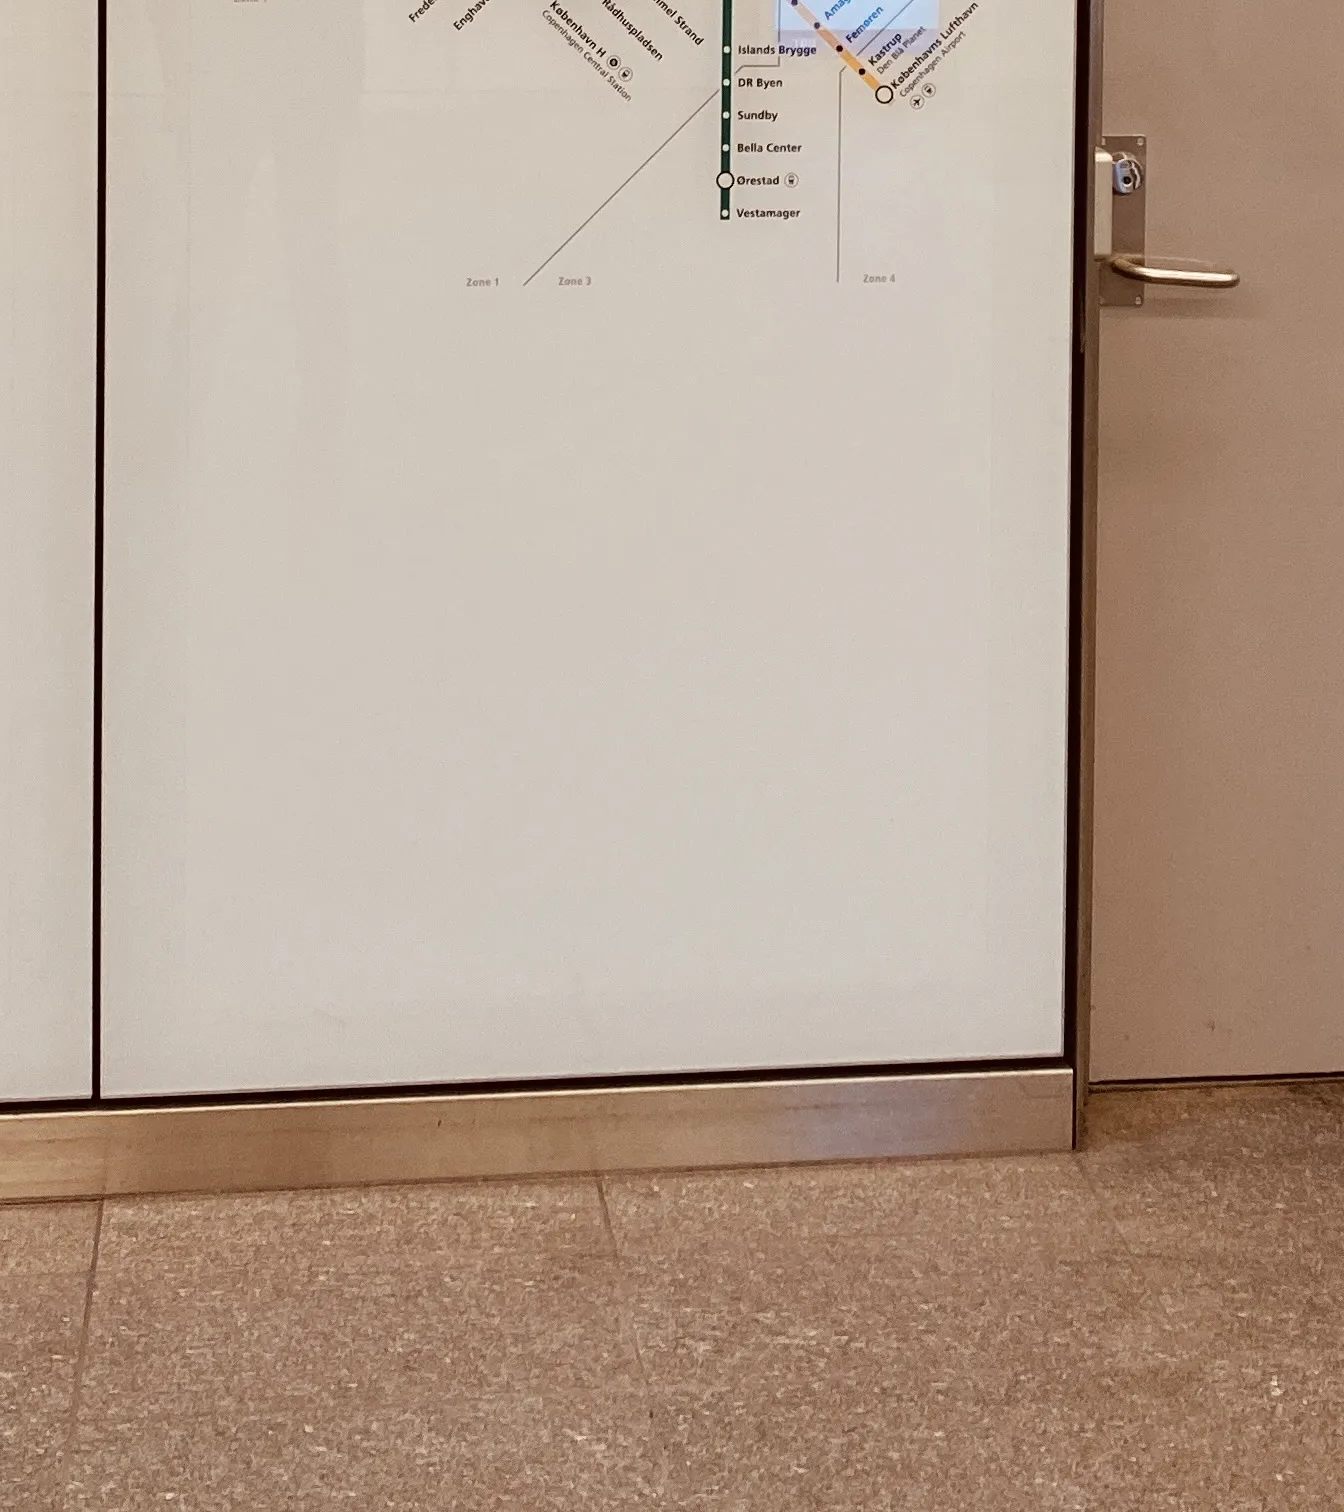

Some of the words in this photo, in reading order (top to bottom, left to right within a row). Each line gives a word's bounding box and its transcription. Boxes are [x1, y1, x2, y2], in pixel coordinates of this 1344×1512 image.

[549, 0, 597, 51] København
[596, 48, 607, 59] H
[674, 14, 705, 46] Strand
[845, 4, 885, 44] Femøren
[738, 45, 776, 55] Islands
[778, 45, 817, 57] Brygge
[868, 31, 903, 67] Kastrup
[876, 58, 893, 76] Den
[902, 25, 928, 51] Planet
[890, 38, 943, 90] Københavns
[939, 0, 979, 42] Lufthavn
[541, 9, 585, 54] Copenhagen
[583, 52, 610, 81] Central
[606, 75, 632, 102] Station
[899, 54, 945, 98] Copenhagen
[942, 31, 967, 58] Airport
[738, 78, 753, 88] DR
[756, 78, 783, 90] Byen
[737, 110, 779, 123] Sundby
[737, 143, 764, 153] Bella
[766, 143, 802, 153] Center
[736, 175, 780, 186] Ørestad
[737, 208, 801, 220] Vestamager
[466, 278, 492, 287] Zone
[558, 276, 583, 286] Zone
[863, 274, 887, 284] Zone
